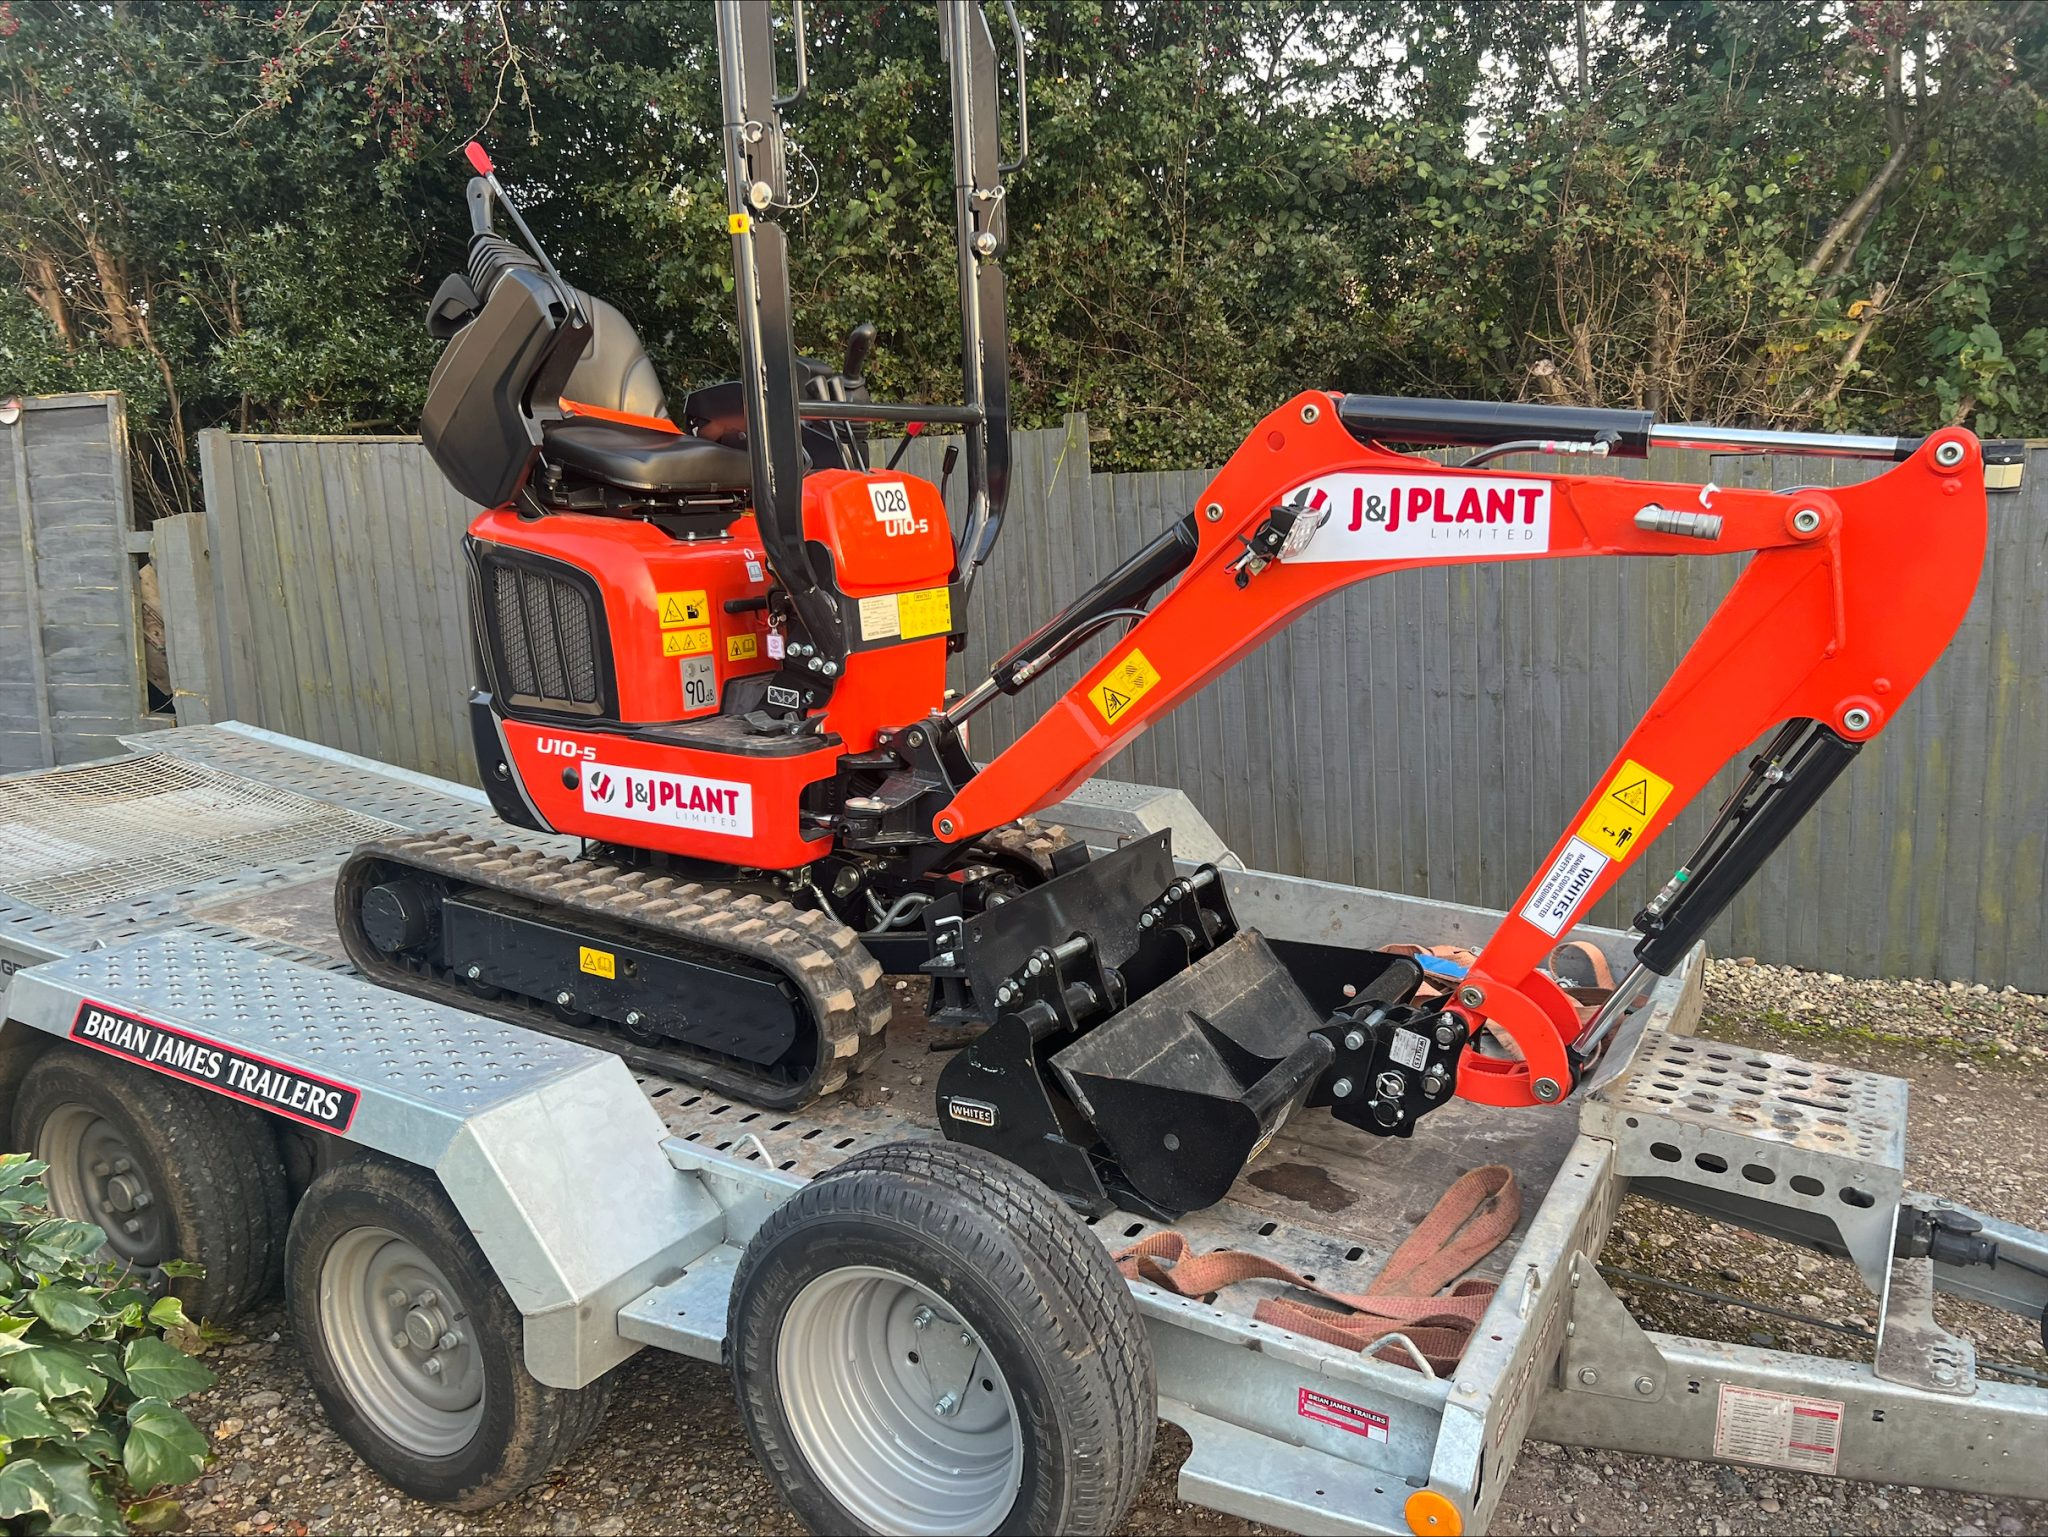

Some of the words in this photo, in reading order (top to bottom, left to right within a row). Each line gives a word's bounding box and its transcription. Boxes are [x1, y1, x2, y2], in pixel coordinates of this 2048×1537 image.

[874, 489, 907, 513] 028
[885, 518, 929, 537] U10-5
[1431, 528, 1534, 541] LIMITED
[685, 679, 705, 706] 90
[536, 737, 597, 761] U10-5
[675, 812, 738, 828] LIMITED
[1558, 852, 1575, 873] SAFETY
[1567, 853, 1586, 876] MANUAL
[1550, 872, 1561, 884] PIN
[1551, 875, 1571, 901] COUPLER
[1533, 881, 1555, 909] REQUIRED
[1552, 867, 1594, 919] WHITES
[1538, 899, 1556, 918] FITTED
[1414, 1038, 1426, 1067] WHITES
[82, 1010, 151, 1054] BRIAN
[145, 1034, 224, 1079] JAMES
[226, 1057, 343, 1121] TRAILERS
[952, 1105, 991, 1122] WHITES
[1308, 1393, 1330, 1406] BRIAN
[1329, 1400, 1352, 1413] JAMES
[1352, 1408, 1387, 1424] TRAILERS
